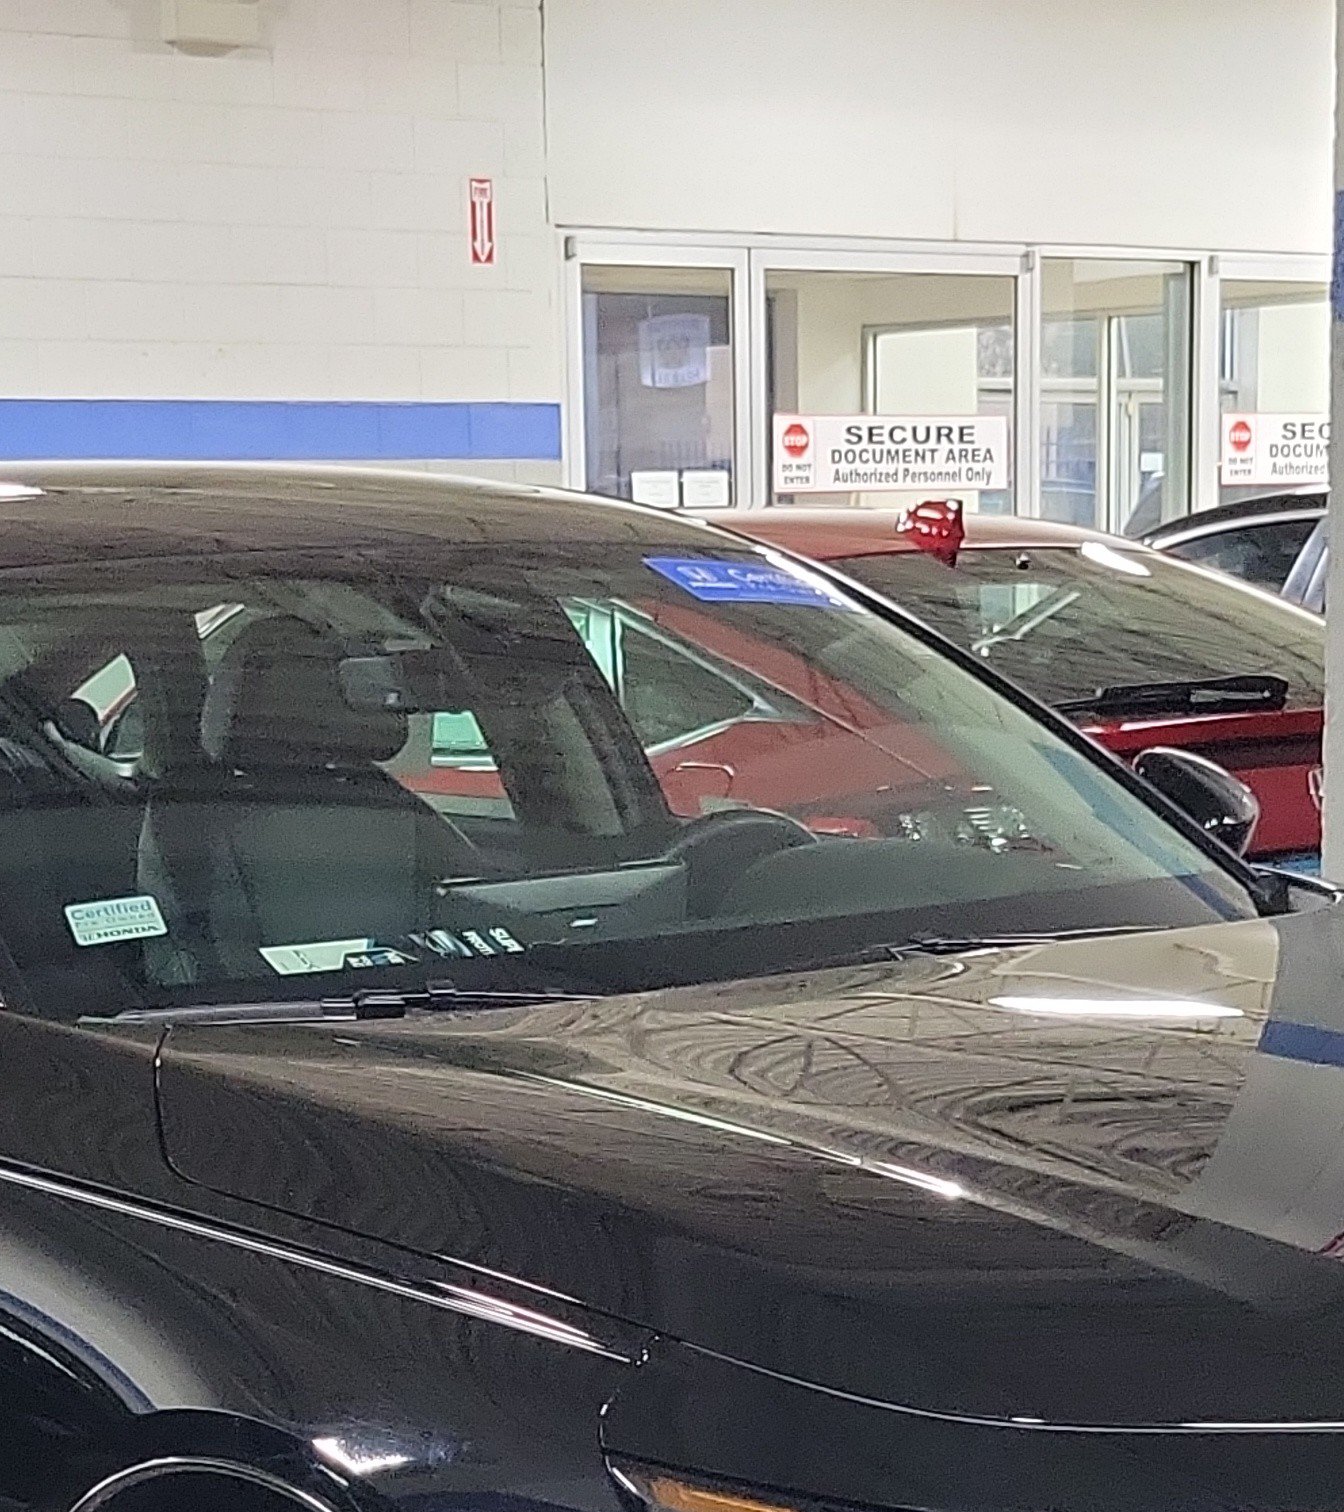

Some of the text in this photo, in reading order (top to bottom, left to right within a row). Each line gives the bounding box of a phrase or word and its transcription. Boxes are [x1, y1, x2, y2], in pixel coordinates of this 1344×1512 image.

[844, 425, 976, 445] SECURE
[831, 448, 995, 465] DOCUMENT AREA
[833, 467, 992, 486] Authorized Personnel Only
